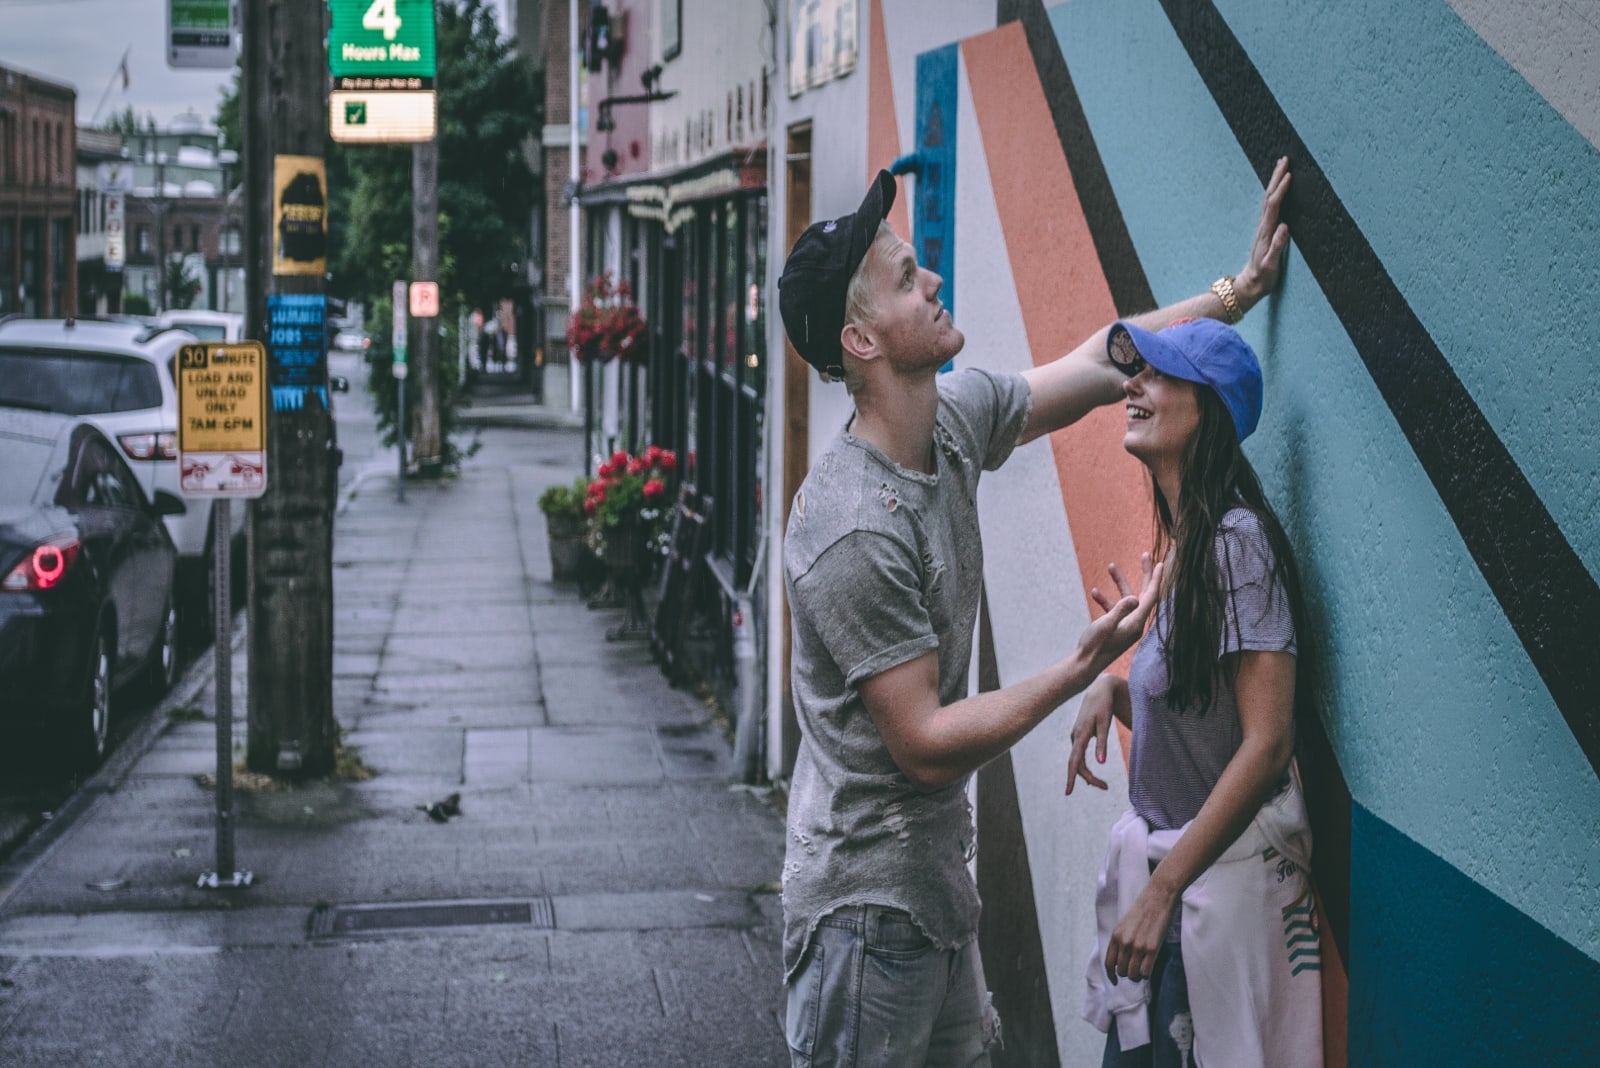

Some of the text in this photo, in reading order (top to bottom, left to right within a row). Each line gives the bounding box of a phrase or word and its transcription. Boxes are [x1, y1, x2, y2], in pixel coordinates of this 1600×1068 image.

[362, 0, 402, 40] 4
[342, 43, 421, 61] Hours Max
[211, 352, 256, 365] MINUTE
[188, 372, 253, 384] LOAD AND
[196, 387, 246, 399] UNLOAD
[205, 402, 236, 414] ONLY
